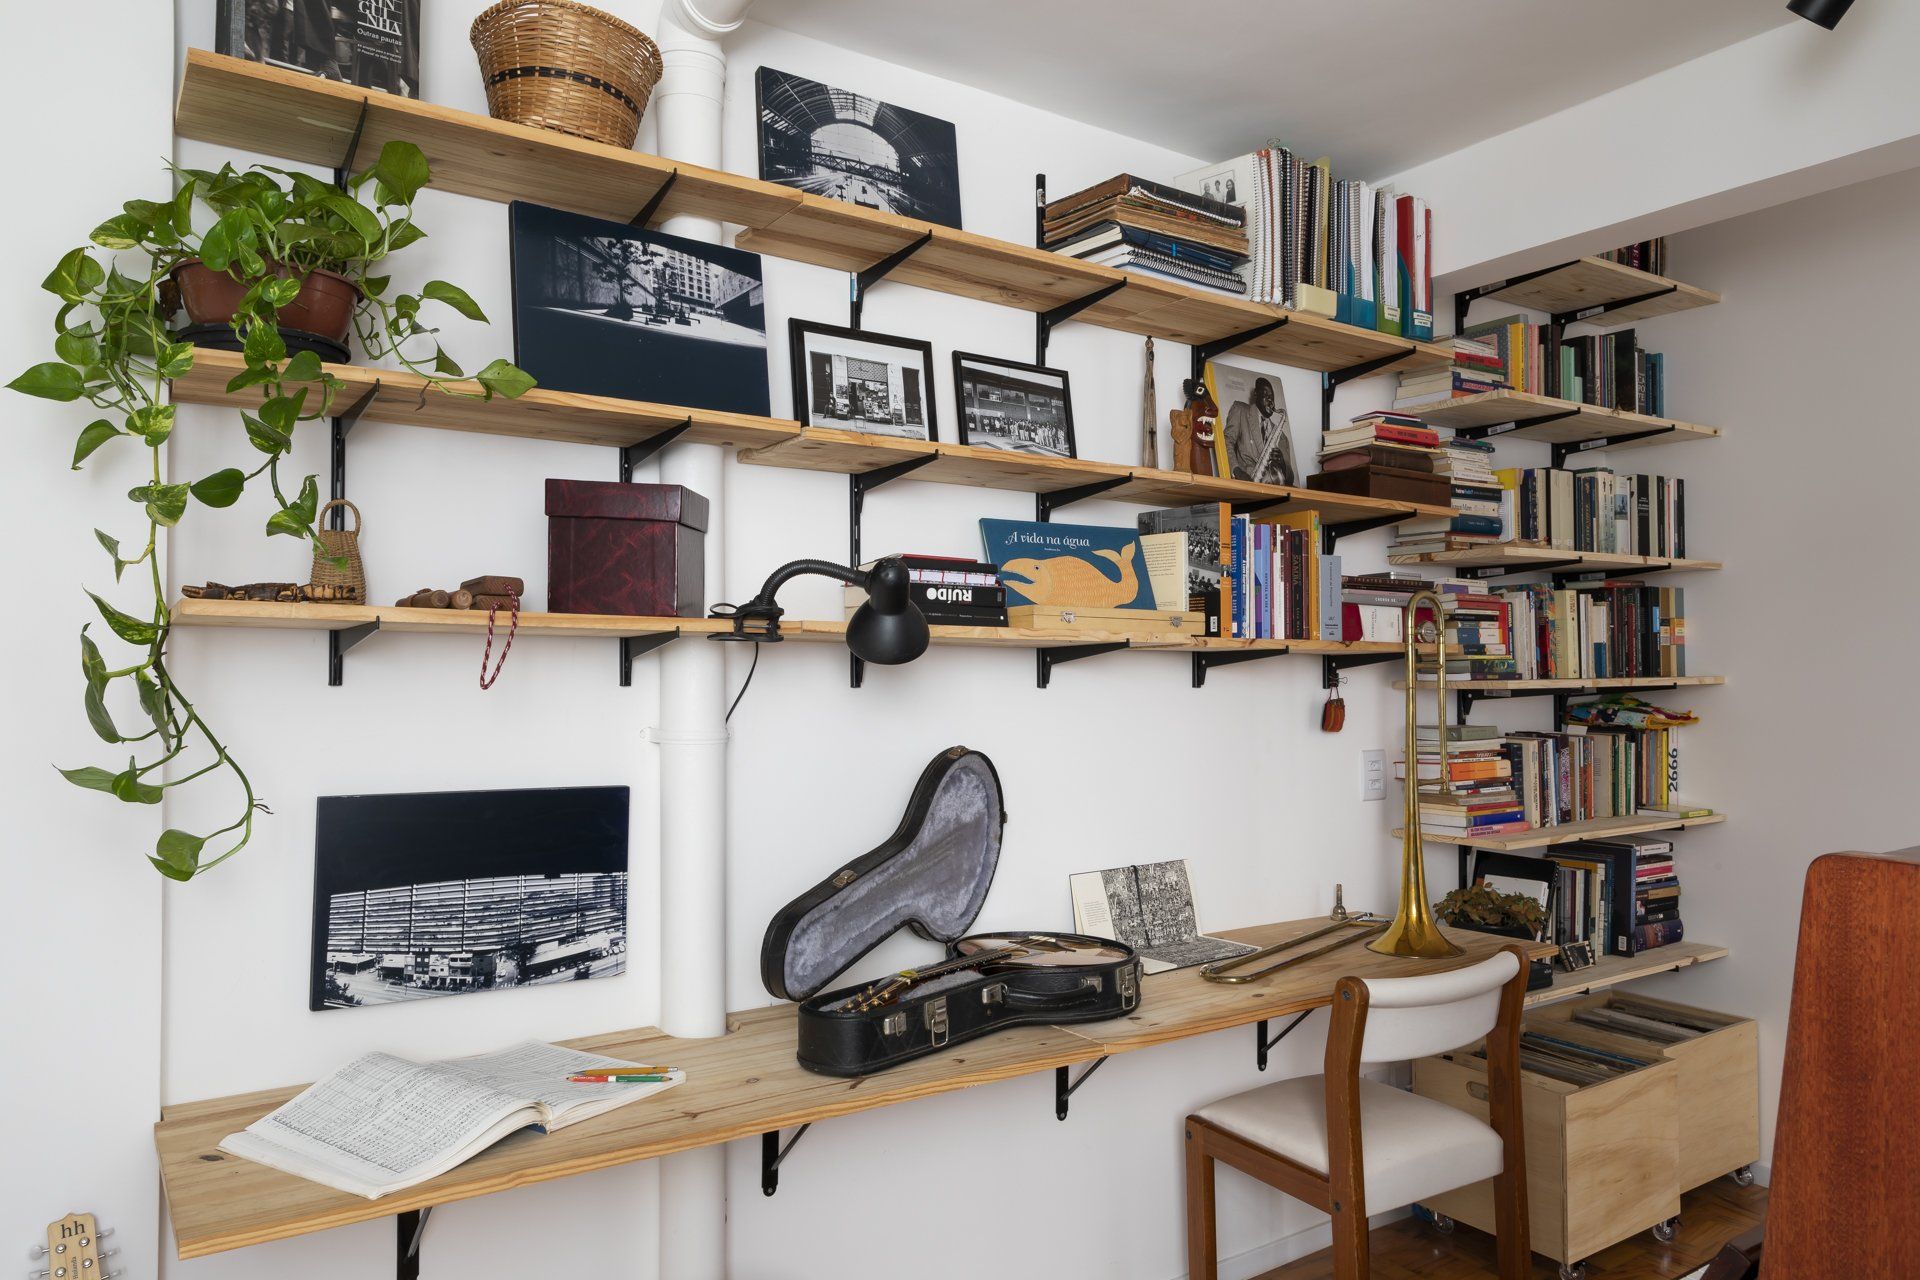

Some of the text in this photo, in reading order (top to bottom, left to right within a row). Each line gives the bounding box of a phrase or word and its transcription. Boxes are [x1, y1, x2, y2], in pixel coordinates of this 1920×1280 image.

[366, 10, 402, 36] NHA
[357, 27, 402, 46] Outras pautas
[1005, 531, 1090, 549] A vida na água
[926, 587, 973, 604] RUÍDO
[1668, 748, 1678, 792] 2666
[60, 1220, 86, 1239] hh
